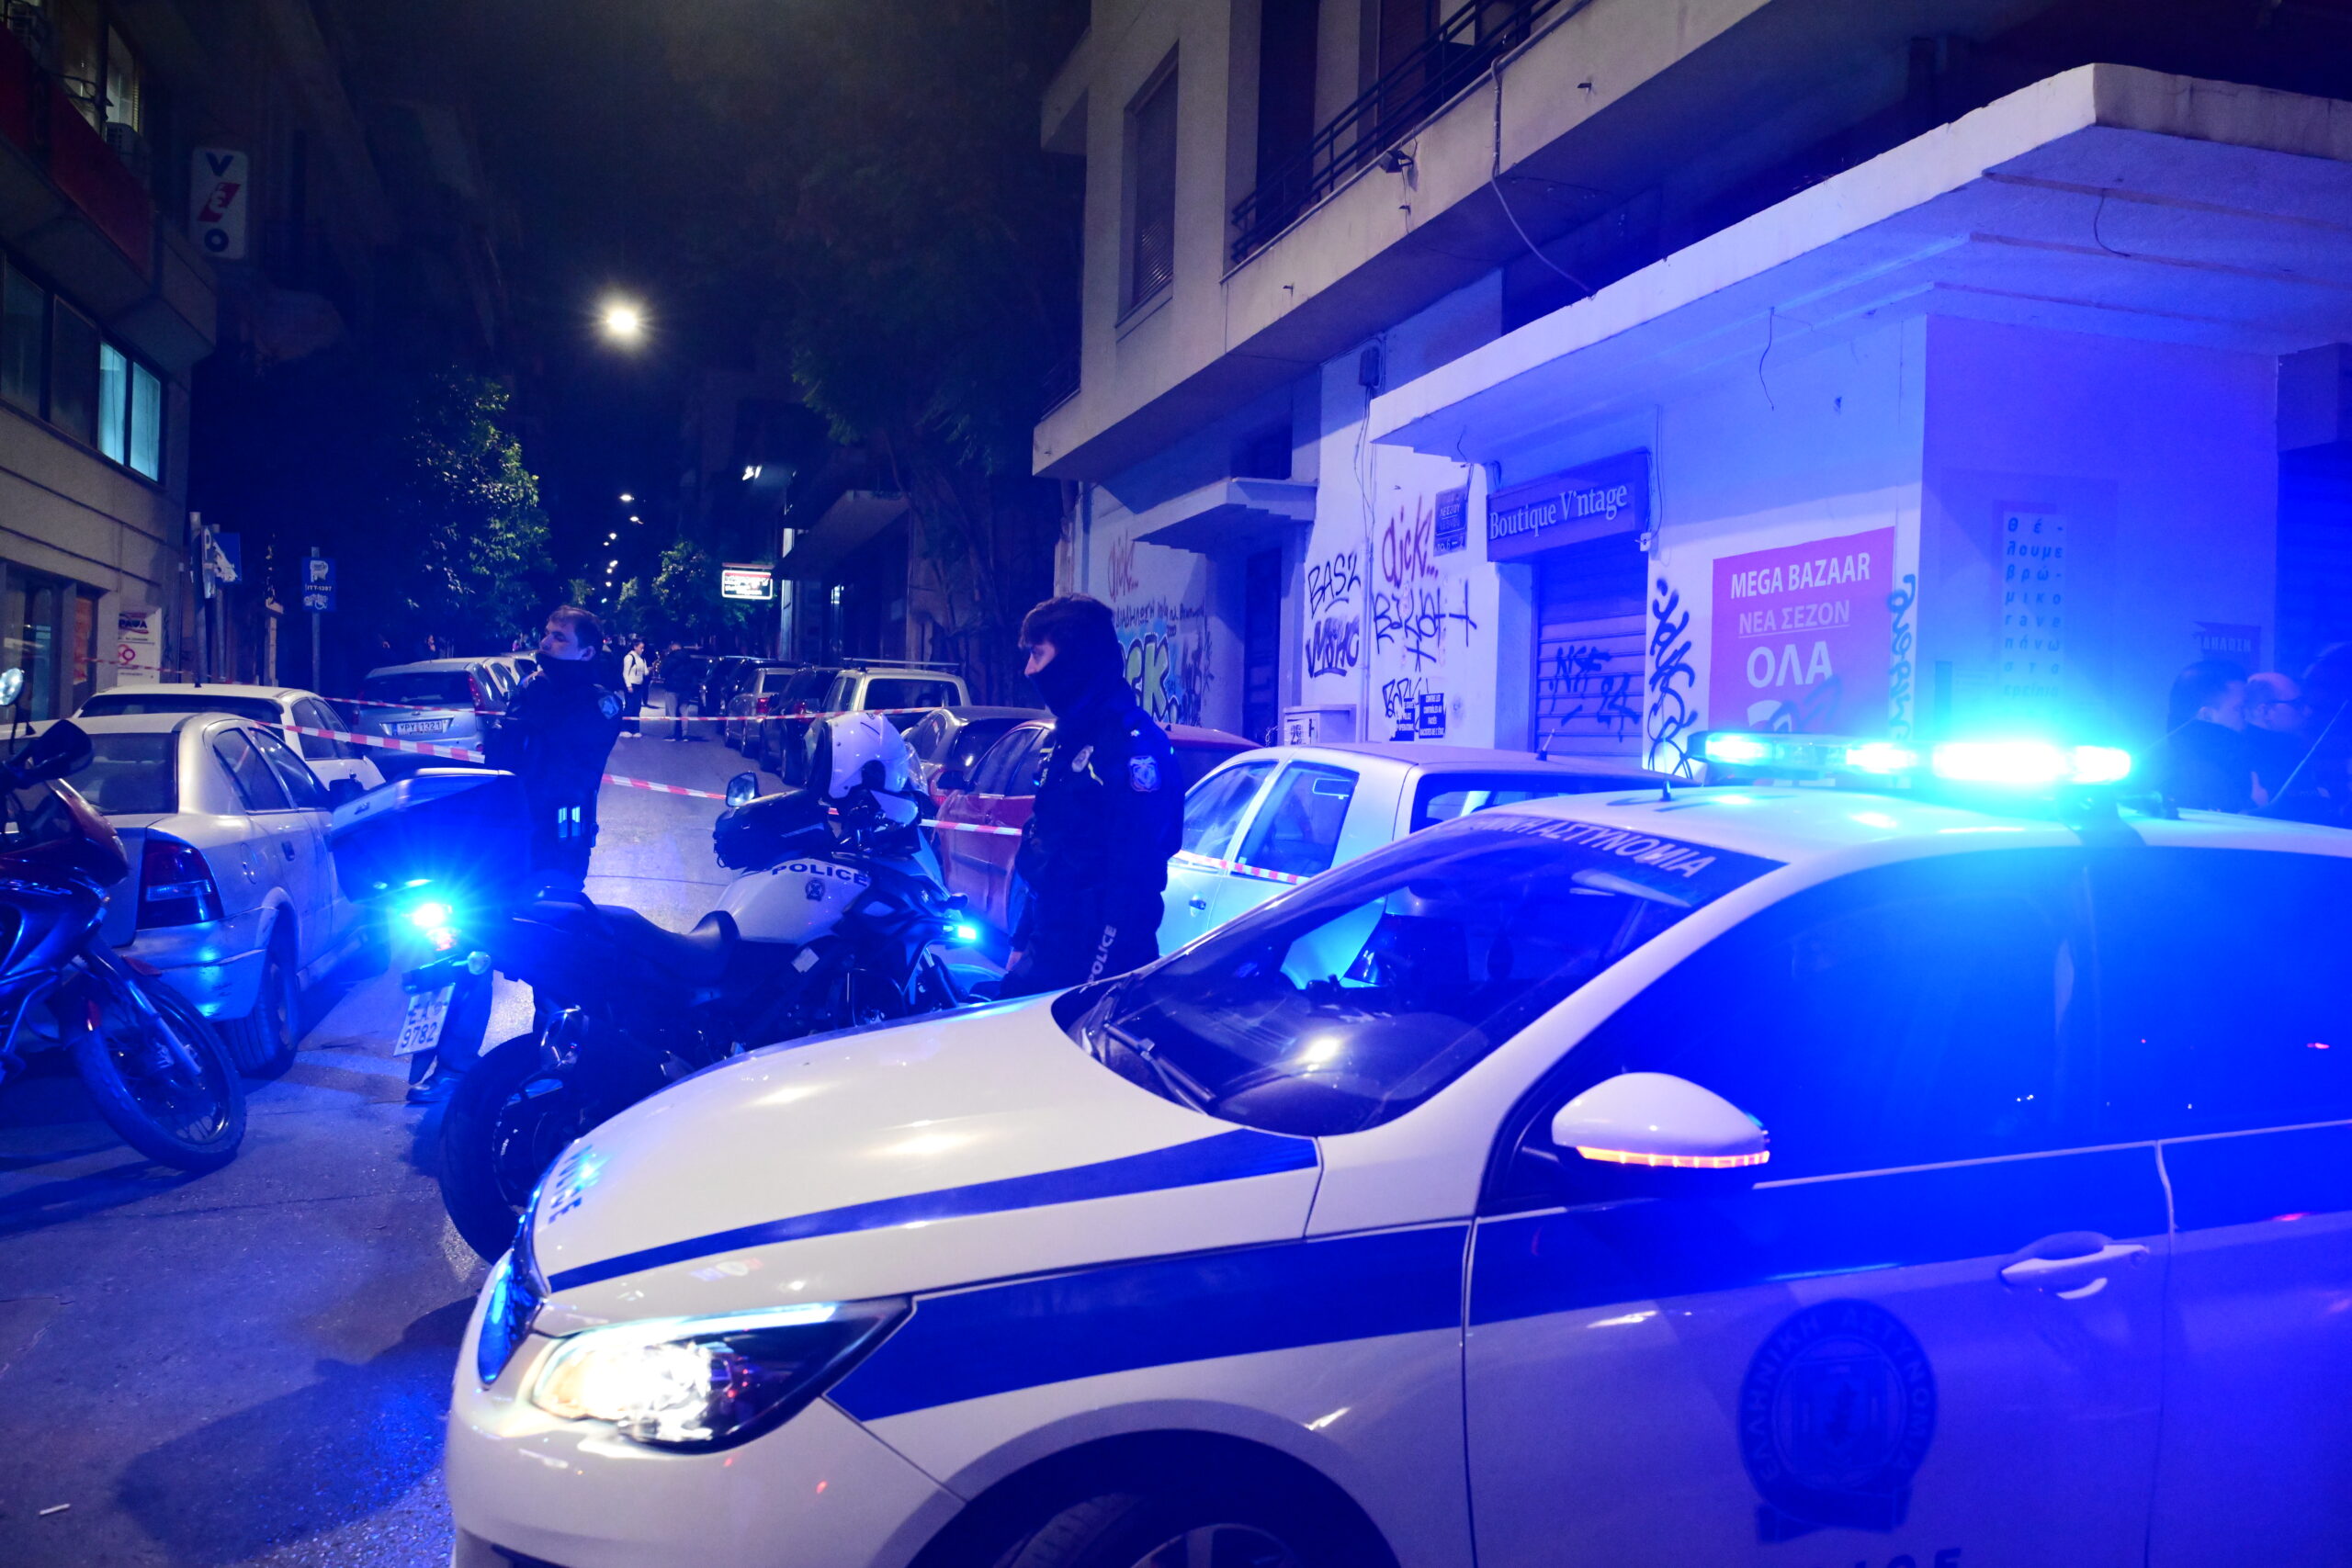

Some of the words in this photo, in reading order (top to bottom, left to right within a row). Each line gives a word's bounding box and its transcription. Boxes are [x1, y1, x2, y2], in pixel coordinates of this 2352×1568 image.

[1489, 502, 1557, 540] Boutique
[1731, 567, 1783, 599] MEGA
[1788, 552, 1871, 591] BAZAAR
[1738, 609, 1777, 635] ΝΕΑ
[1781, 599, 1850, 630] ΣΕΖΟΝ
[2005, 614, 2061, 627] rave
[1746, 640, 1834, 689] ΟΛΑ
[771, 863, 870, 887] POLICE
[401, 1021, 437, 1048] 9782
[1746, 1314, 1822, 1483] ΕΛΛΗΝΙΚΗ
[1840, 1306, 1929, 1472] ΑΣΤΥΝΟΜΙΑ
